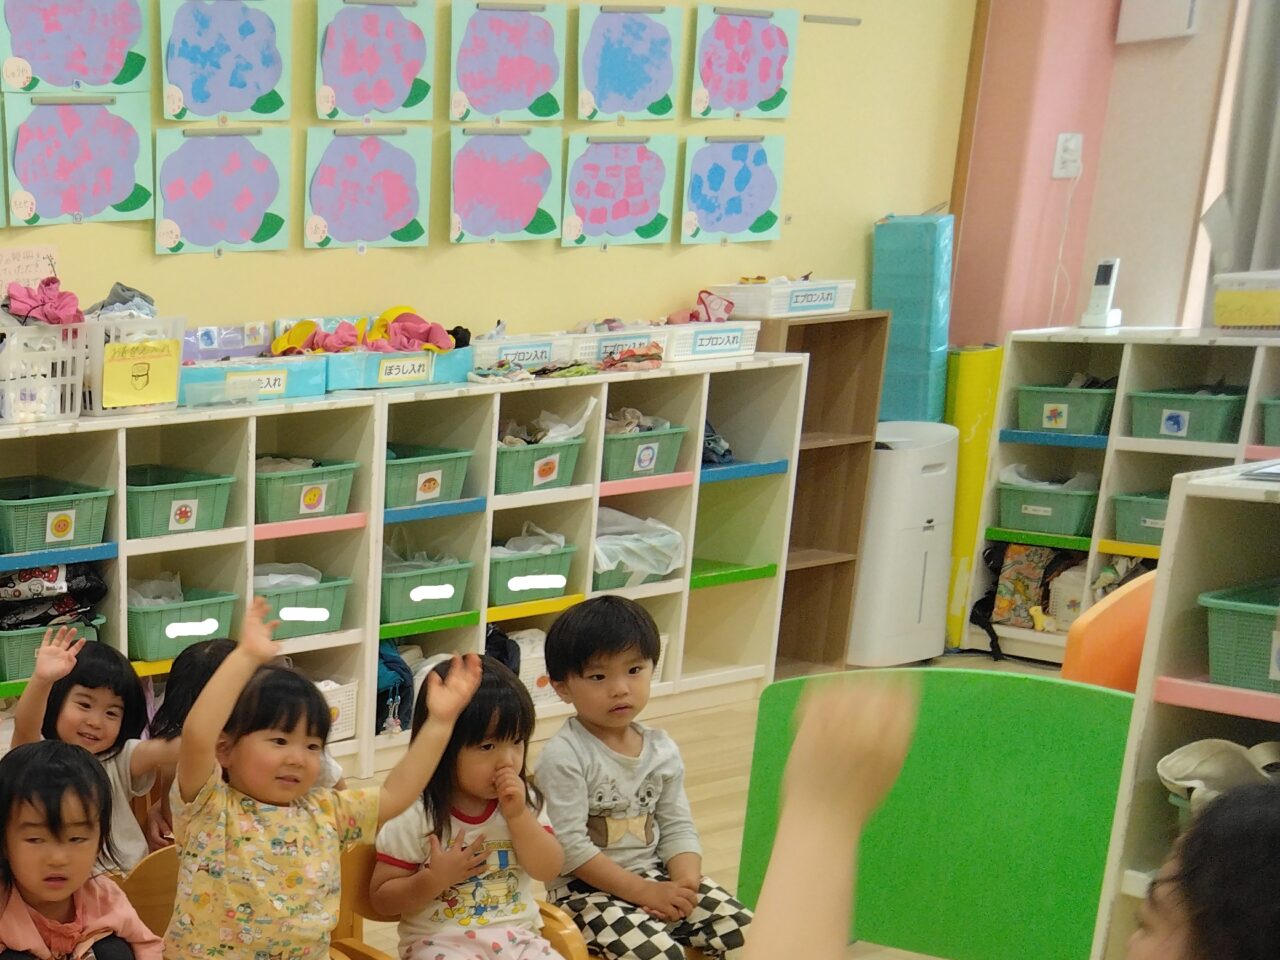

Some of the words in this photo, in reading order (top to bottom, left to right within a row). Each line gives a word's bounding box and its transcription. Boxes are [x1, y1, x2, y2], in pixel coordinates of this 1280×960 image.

[793, 292, 833, 304] エプロン入れ
[697, 335, 739, 347] エプロン入れ
[503, 350, 548, 364] エプロン入れ
[384, 364, 426, 376] ぼうし入れ
